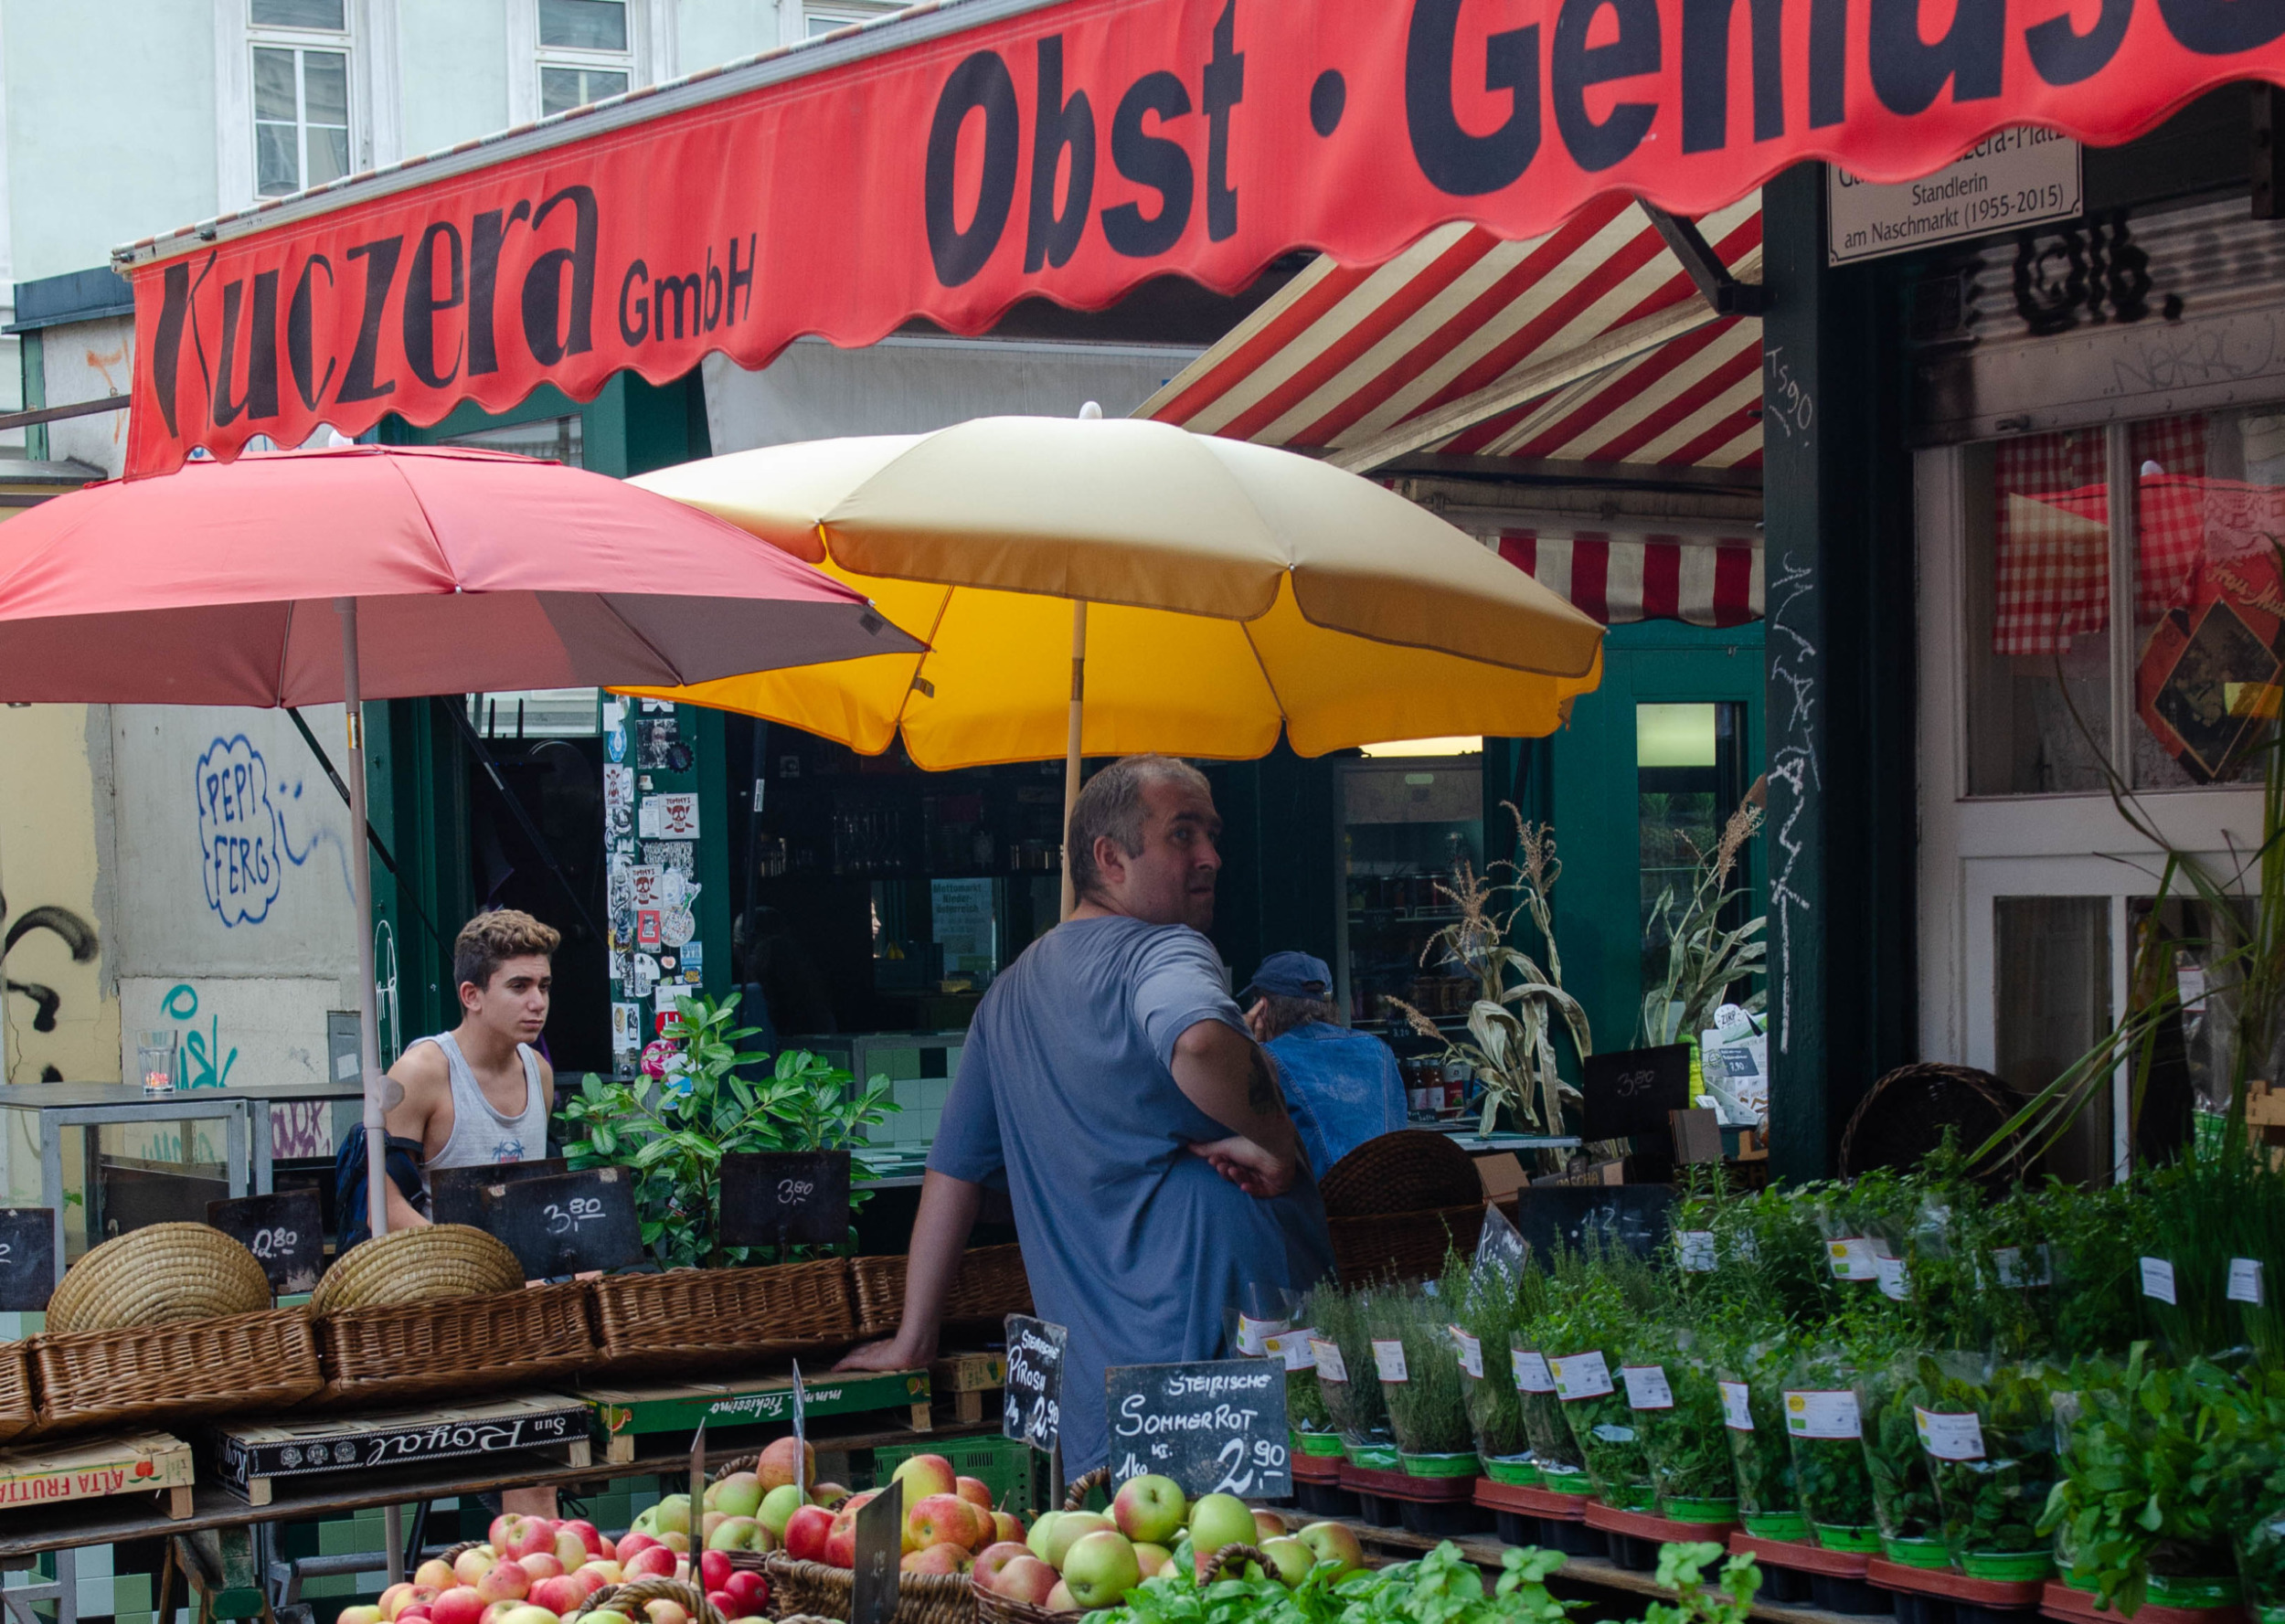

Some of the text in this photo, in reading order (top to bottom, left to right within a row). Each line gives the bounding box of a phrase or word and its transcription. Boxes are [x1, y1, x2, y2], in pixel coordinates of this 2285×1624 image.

[1844, 183, 2064, 249] am Naschmarkt (1955-2015)
[1911, 173, 1988, 207] Standlerin
[153, 184, 600, 440] Kuczera
[619, 231, 759, 349] GmbH
[924, 0, 1246, 290] Obst
[206, 762, 256, 826] PEPI
[214, 834, 270, 897] FERG
[1720, 1010, 1737, 1025] ZIRP
[367, 1416, 567, 1464] Sun Royal
[78, 1469, 124, 1494] ALTA
